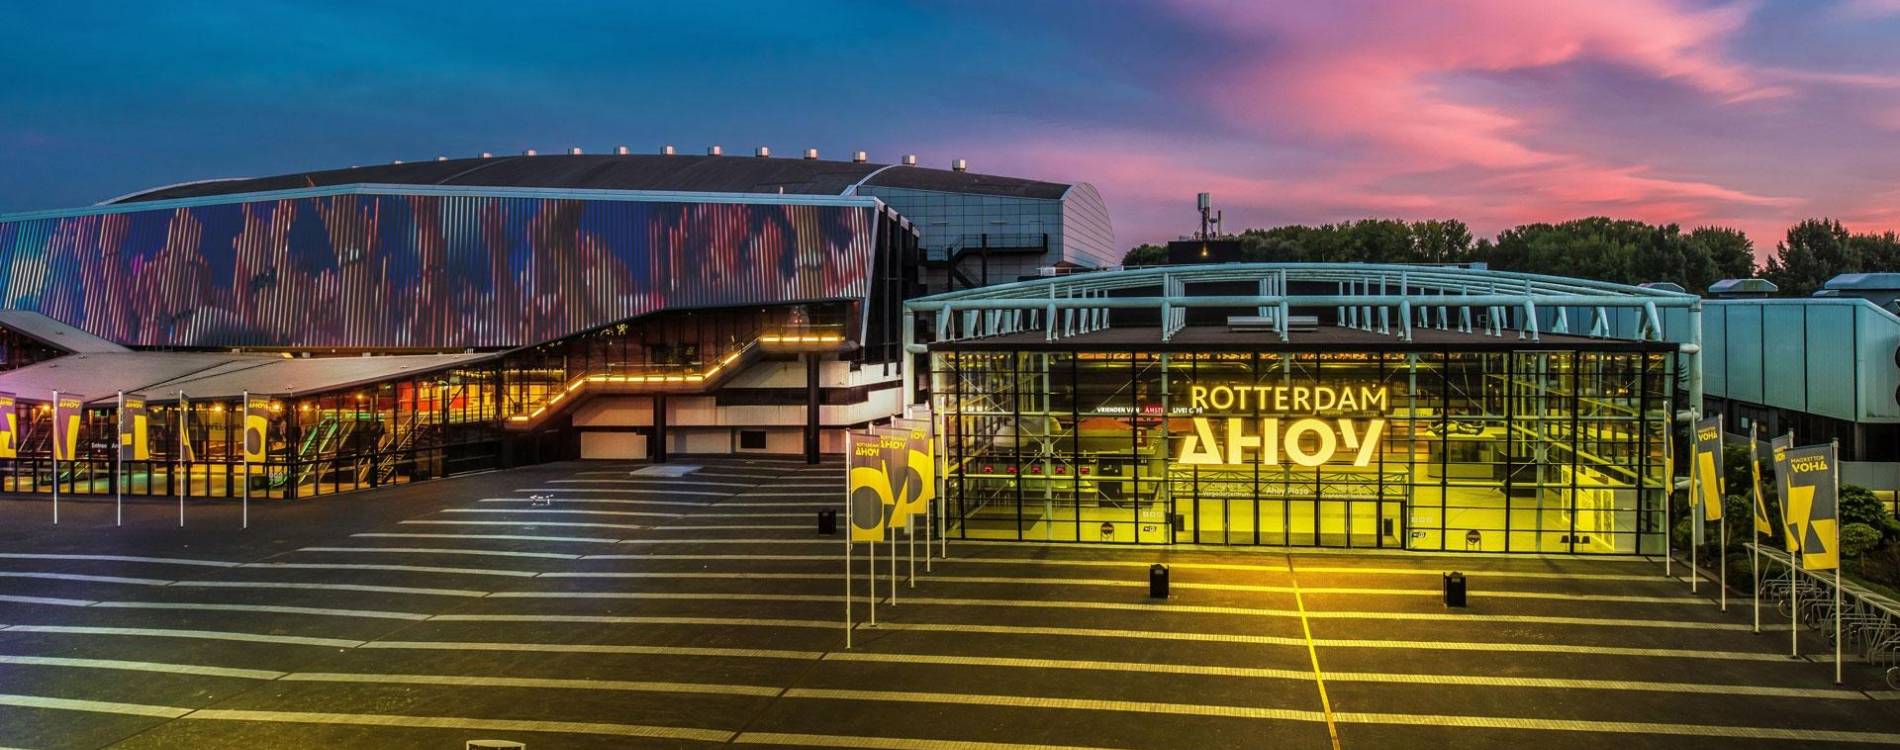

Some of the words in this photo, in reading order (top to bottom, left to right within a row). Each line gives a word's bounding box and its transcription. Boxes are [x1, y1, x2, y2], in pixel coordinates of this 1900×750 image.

[1191, 386, 1388, 411] ROTTERDAM
[855, 447, 880, 456] AHOY
[1178, 417, 1386, 467] AHOY
